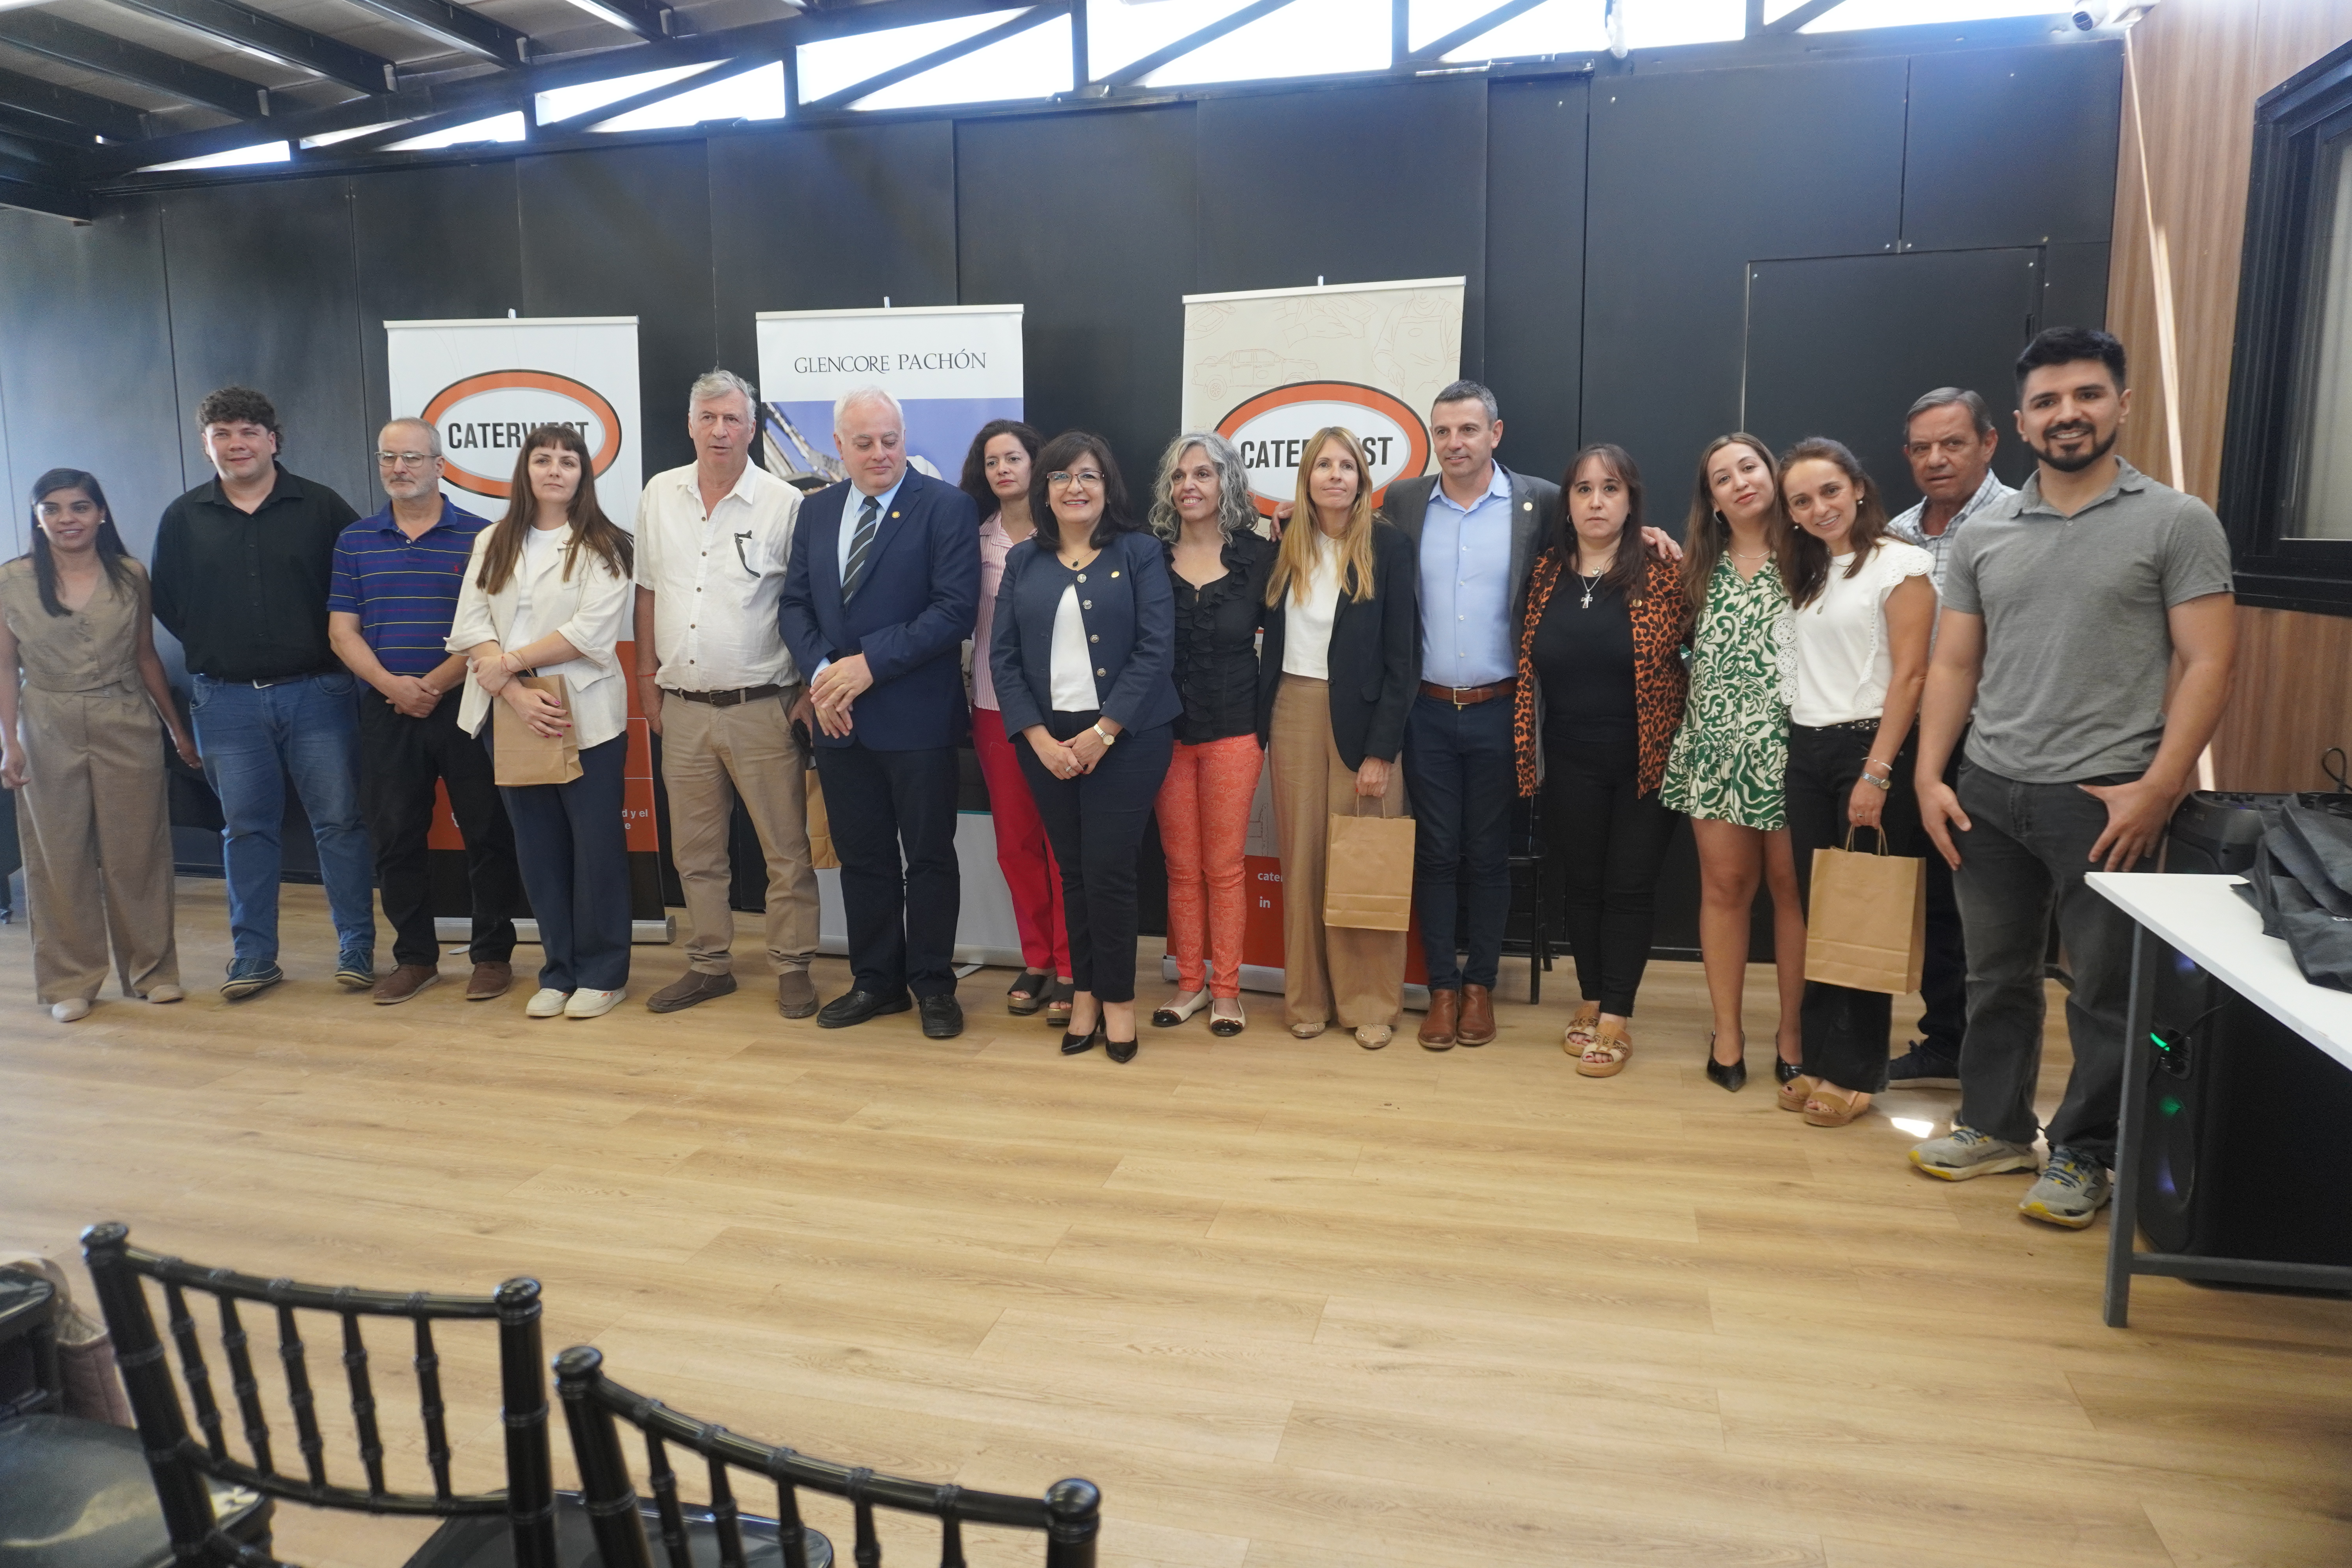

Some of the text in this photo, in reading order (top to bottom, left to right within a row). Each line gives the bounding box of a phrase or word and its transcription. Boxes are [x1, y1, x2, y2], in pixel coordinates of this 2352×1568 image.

[794, 348, 987, 374] GLENCORE PACHÓN
[448, 421, 589, 449] CATERT
[1241, 436, 1394, 469] CATEST
[630, 810, 636, 819] y
[639, 809, 648, 817] el
[1259, 896, 1271, 908] in
